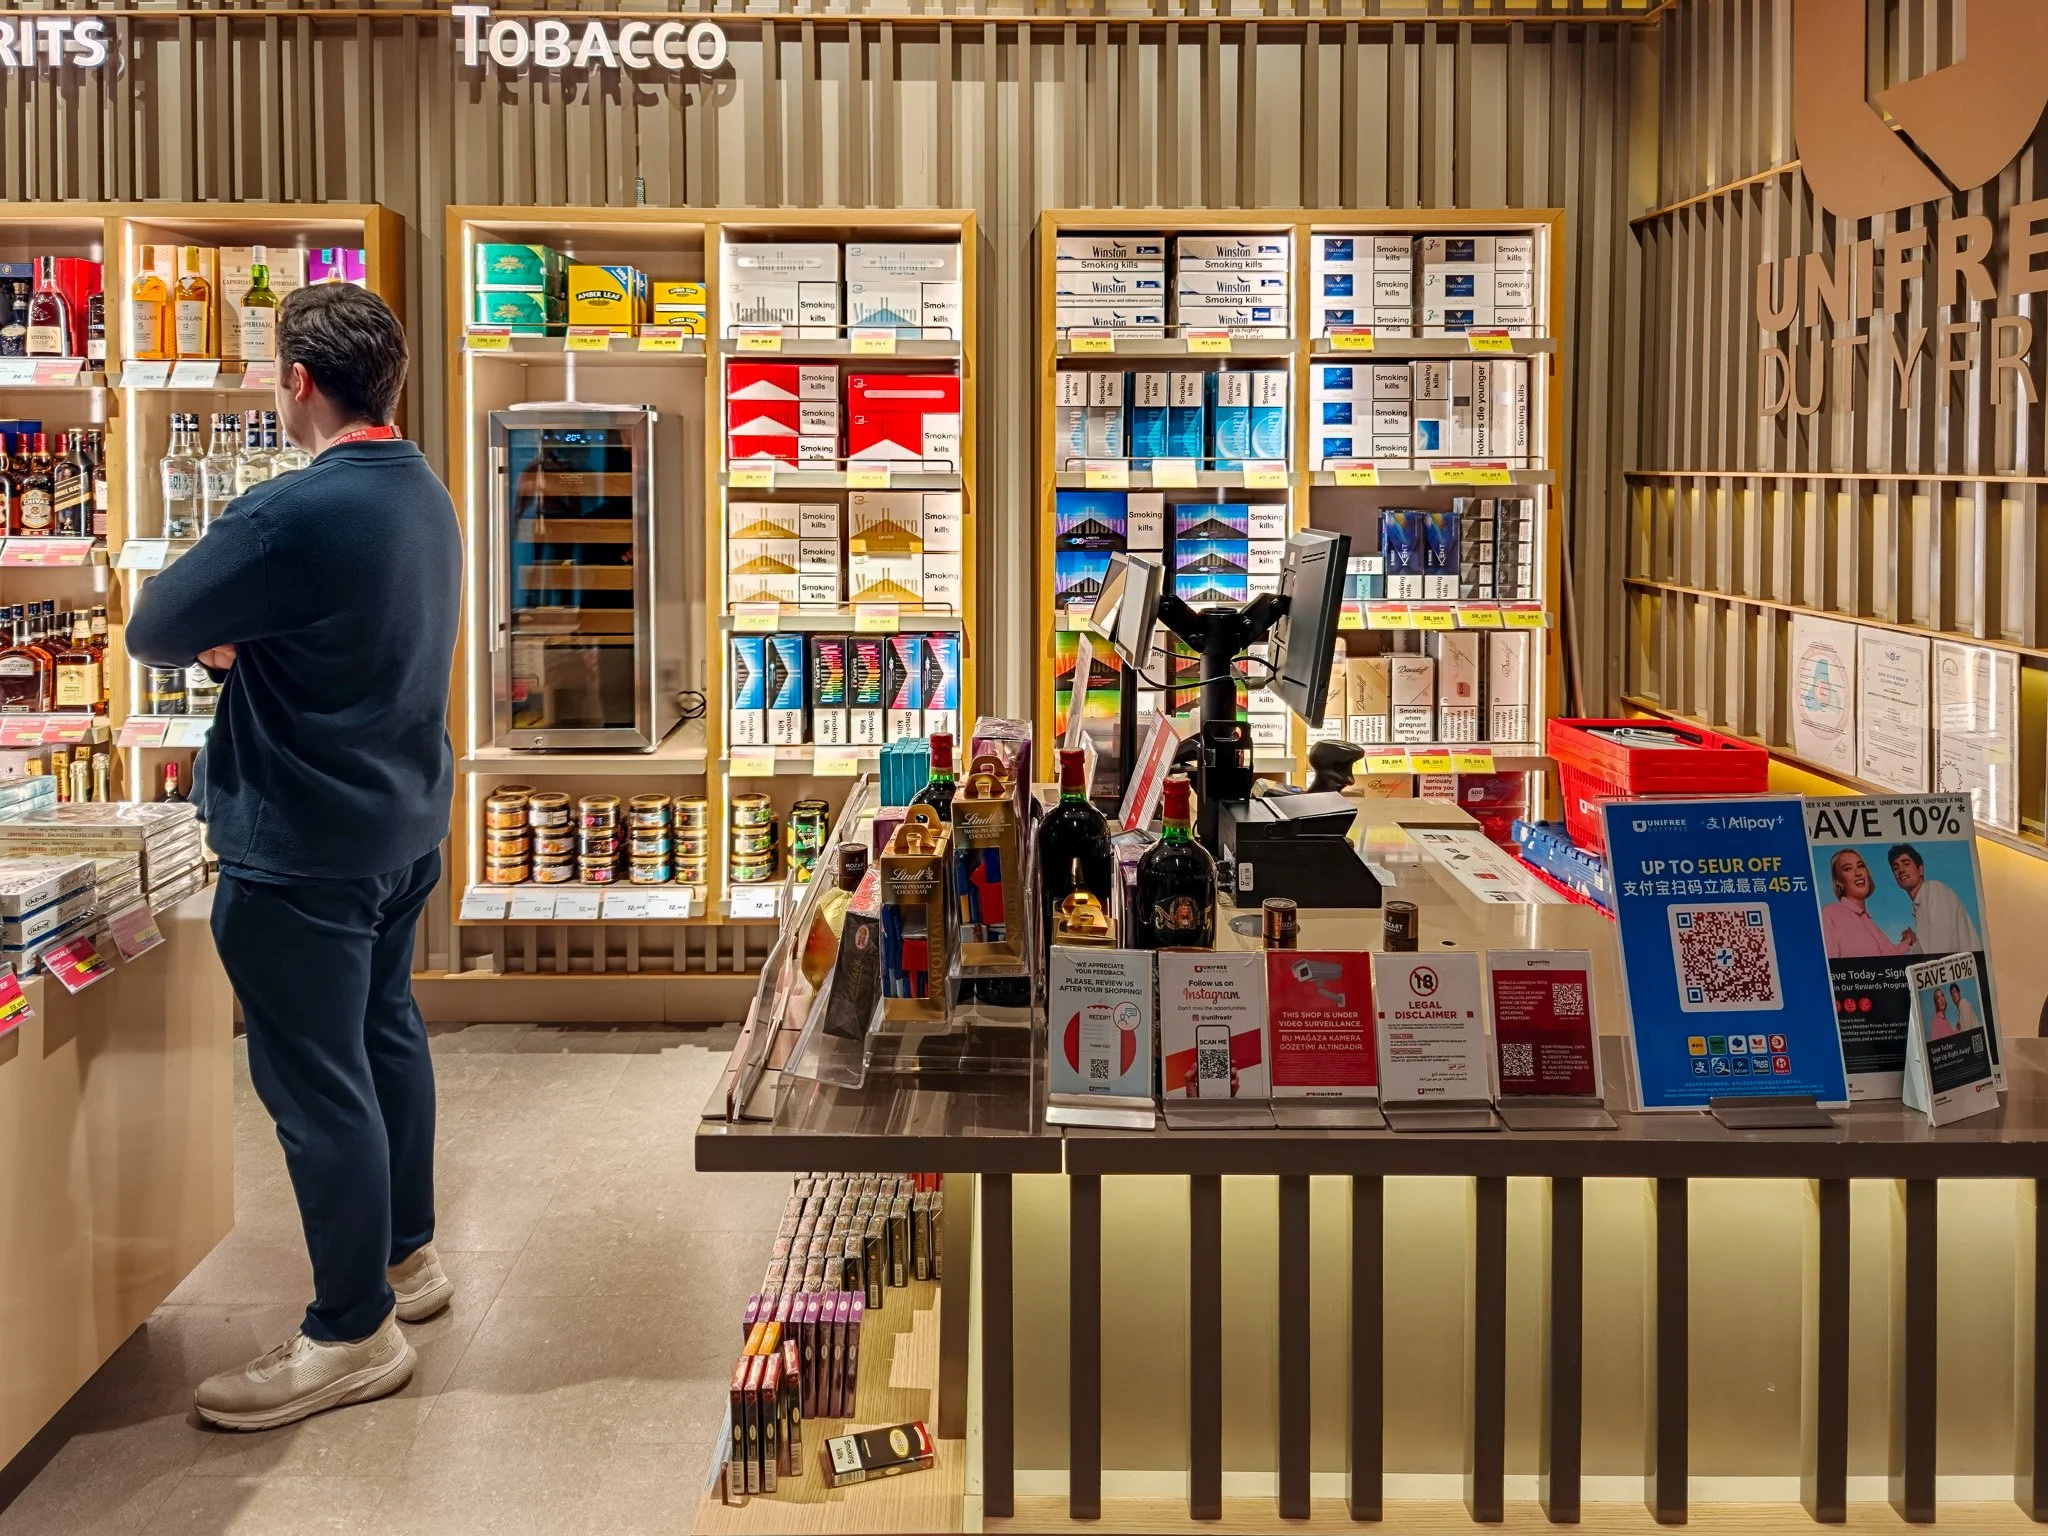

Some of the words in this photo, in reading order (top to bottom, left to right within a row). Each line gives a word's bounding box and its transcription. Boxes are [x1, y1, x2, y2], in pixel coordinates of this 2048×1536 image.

[451, 6, 727, 70] TOBACCO
[1092, 246, 1127, 258] Winston
[1216, 245, 1250, 257] Winston
[1377, 246, 1409, 254] Smoking
[1081, 261, 1119, 269] Smoking
[1121, 260, 1138, 269] kills
[1092, 282, 1126, 293] Winston
[577, 291, 601, 301] AMBER
[603, 291, 622, 301] LEAF
[731, 296, 793, 323] Marlboro
[801, 301, 835, 310] Smoking
[853, 297, 917, 323] Marlboro
[810, 314, 826, 322] kills
[802, 374, 834, 383] Smoking
[1376, 374, 1408, 382] Smoking
[810, 382, 825, 390] kills
[1129, 511, 1162, 519] Smoking
[1397, 665, 1429, 674] Davidoff
[1399, 721, 1427, 729] pregnant
[962, 813, 995, 825] Lindt
[1808, 808, 1882, 839] AVE
[1641, 860, 1665, 875] UP
[1669, 860, 1694, 874] TO
[1698, 859, 1743, 874] 5EUR
[1748, 857, 1782, 873] OFF
[890, 868, 925, 881] Lindt
[1623, 876, 1808, 897] 支付宝扫码立减最高45元
[1384, 922, 1403, 930] OZART
[47, 949, 68, 964] SPECIAL
[1831, 972, 1846, 980] ave
[1848, 969, 1876, 980] Today
[1917, 967, 1947, 989] SAVE
[1105, 987, 1142, 995] SHOPPING!
[1183, 987, 1240, 1004] Instagram
[1409, 1001, 1442, 1009] LEGAL
[1395, 1011, 1457, 1019] DISCLAIMER
[1294, 1033, 1327, 1042] MAĞAZA
[1280, 1042, 1316, 1050] GÖZETİMİ
[1931, 1045, 1940, 1054] Save
[844, 1440, 855, 1464] Smoking
